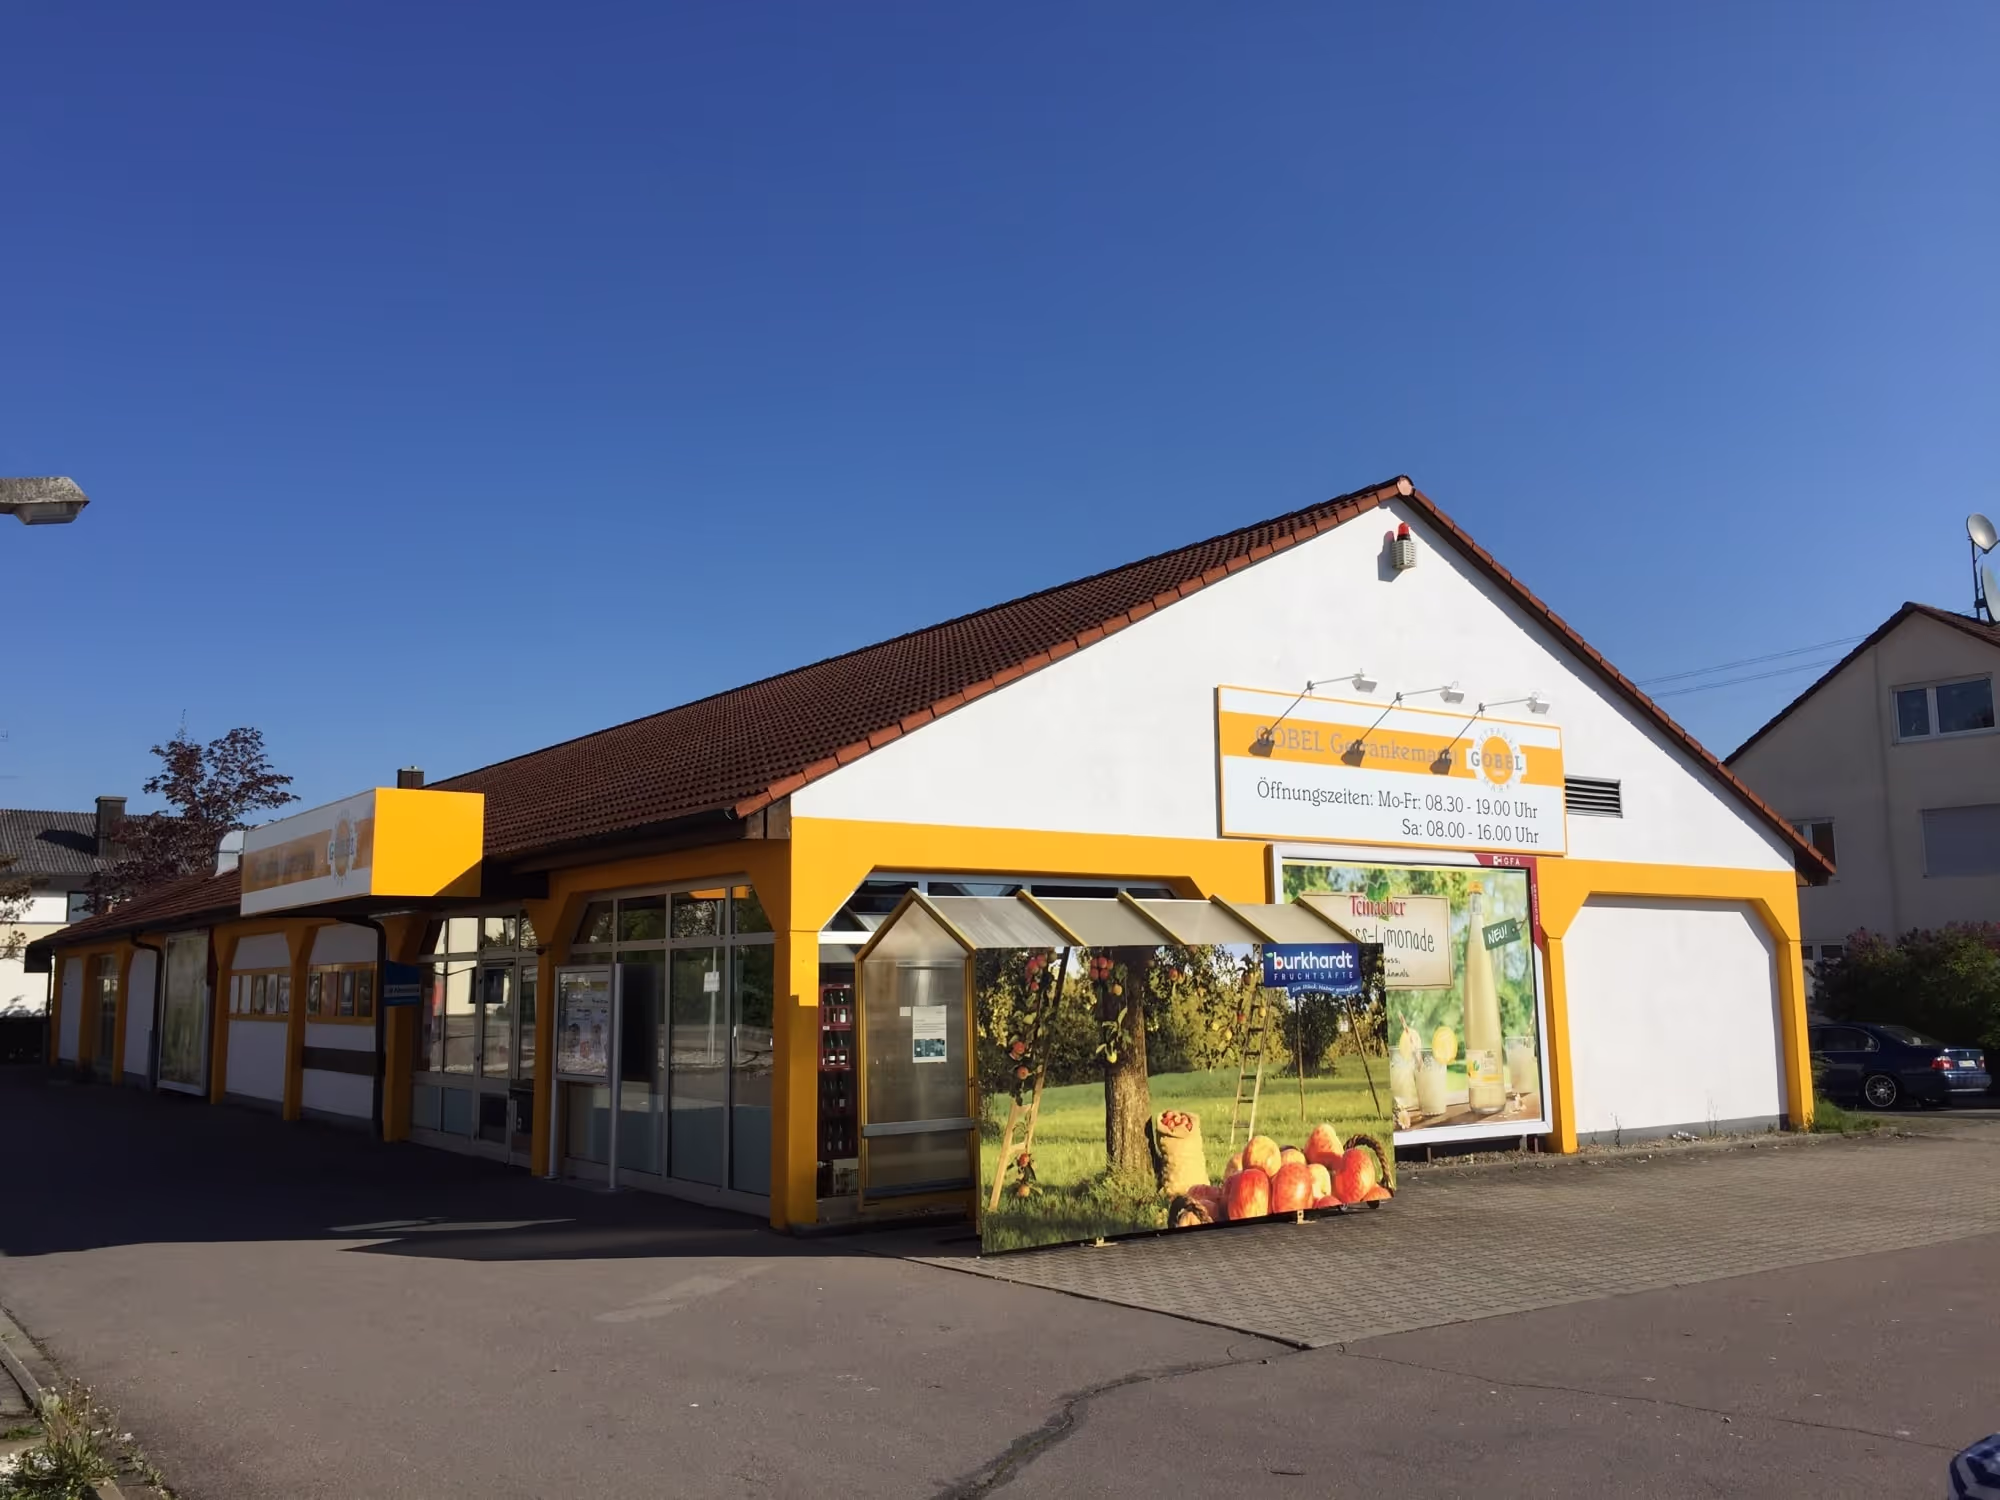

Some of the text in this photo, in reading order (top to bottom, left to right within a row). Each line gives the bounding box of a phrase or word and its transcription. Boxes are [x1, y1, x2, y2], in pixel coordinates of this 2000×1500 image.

[1256, 777, 1374, 807] Öffnungszeiten:
[1378, 790, 1421, 810] Mo-Fr:
[1425, 794, 1464, 813] 08.30
[1476, 798, 1511, 817] 19.00
[1514, 801, 1538, 819] Uhr
[1402, 818, 1423, 836] Sa:
[1426, 820, 1465, 839] 08.00
[1477, 823, 1512, 842] 16.00
[1515, 826, 1539, 844] Uhr
[1350, 924, 1435, 953] ss-Limonade
[1487, 924, 1508, 945] NEU!
[1273, 950, 1354, 970] burkhardt
